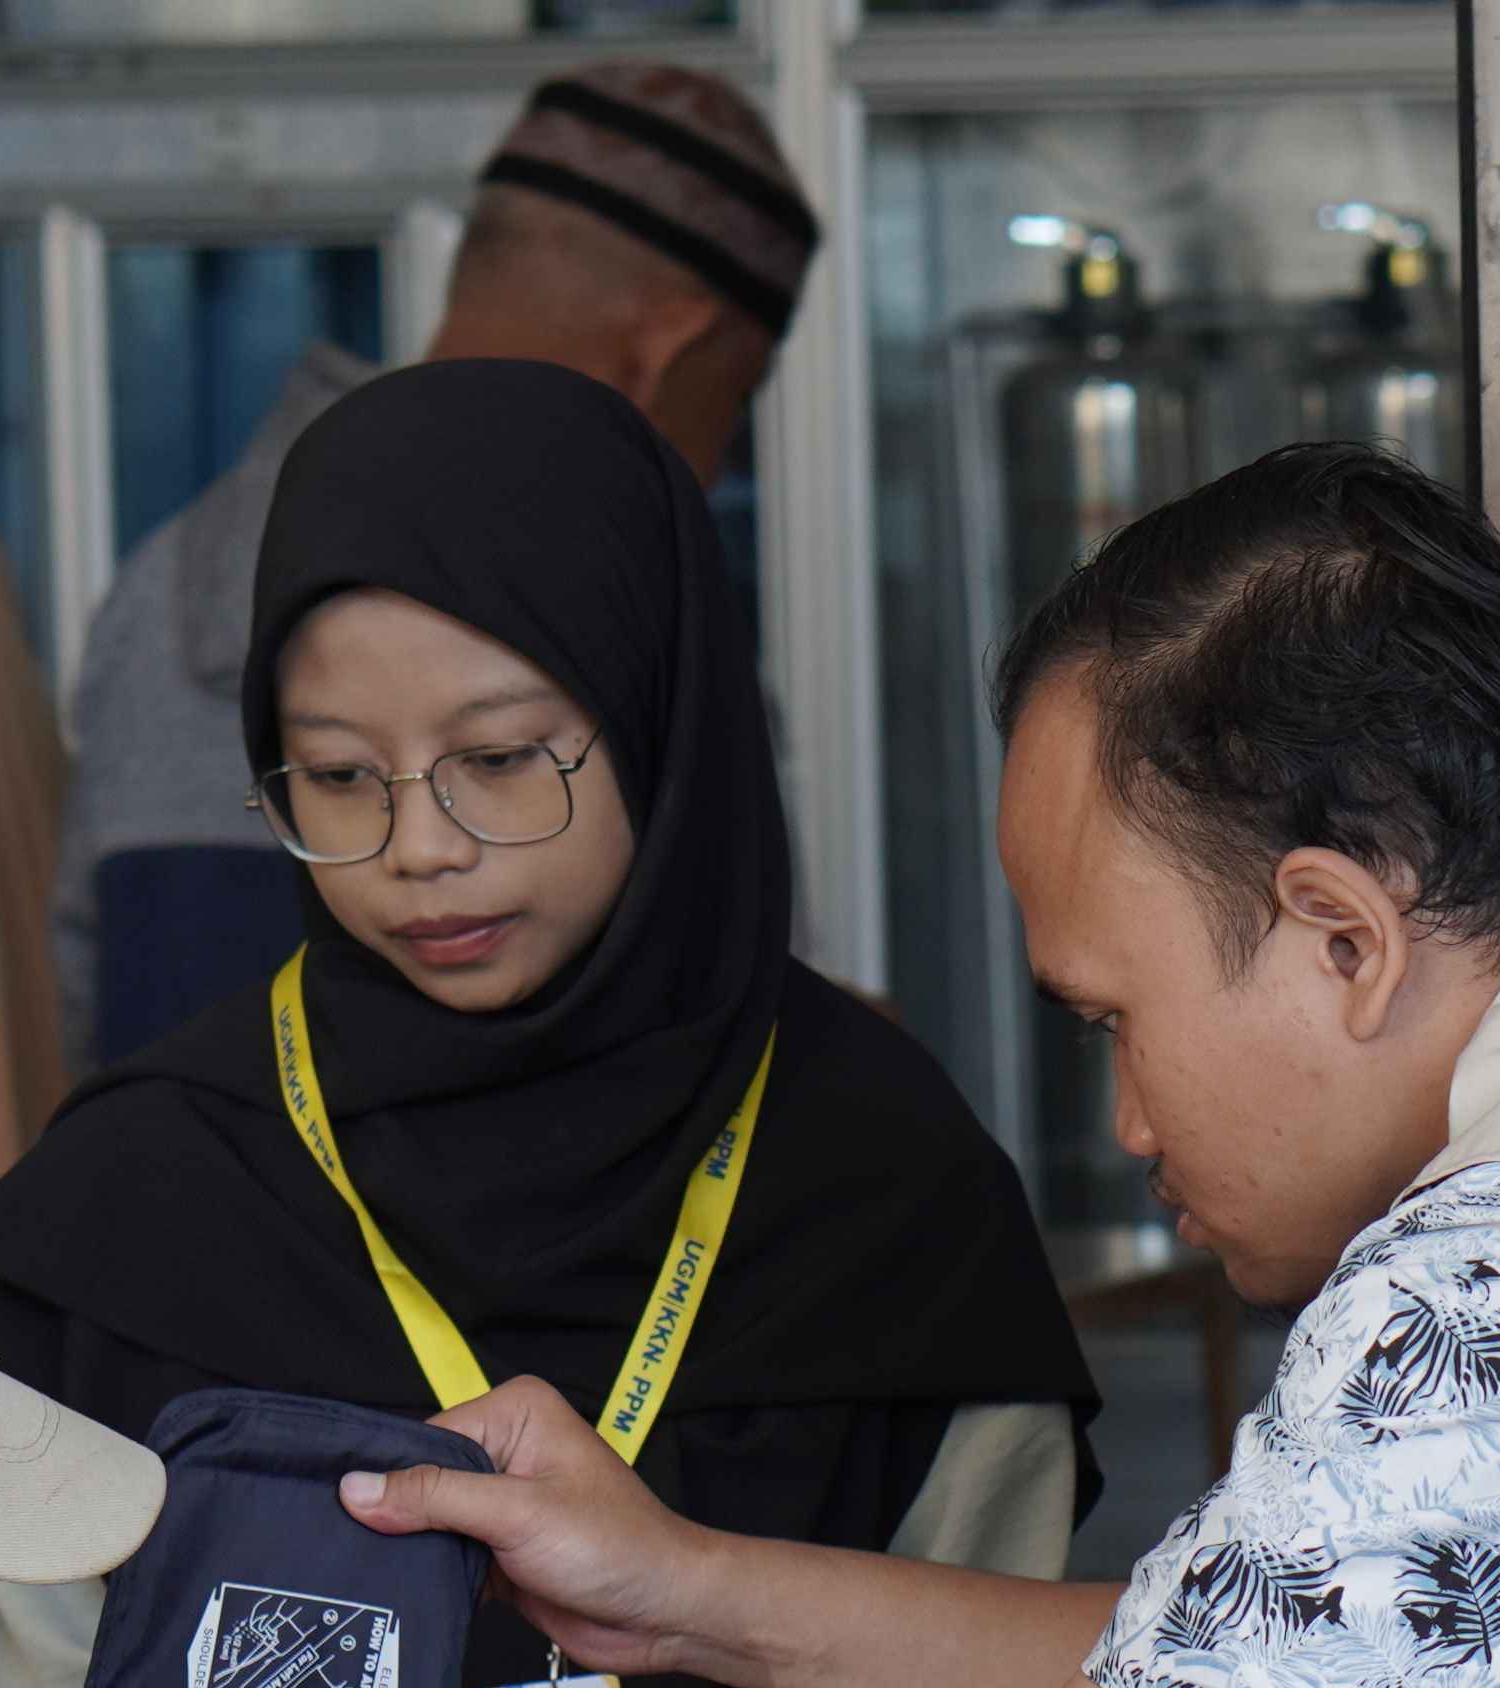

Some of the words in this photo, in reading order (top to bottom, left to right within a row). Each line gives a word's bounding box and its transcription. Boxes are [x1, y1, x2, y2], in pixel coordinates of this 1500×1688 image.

[612, 1376, 652, 1435] PPM
[370, 1617, 387, 1652] HOW
[364, 1654, 379, 1674] TO
